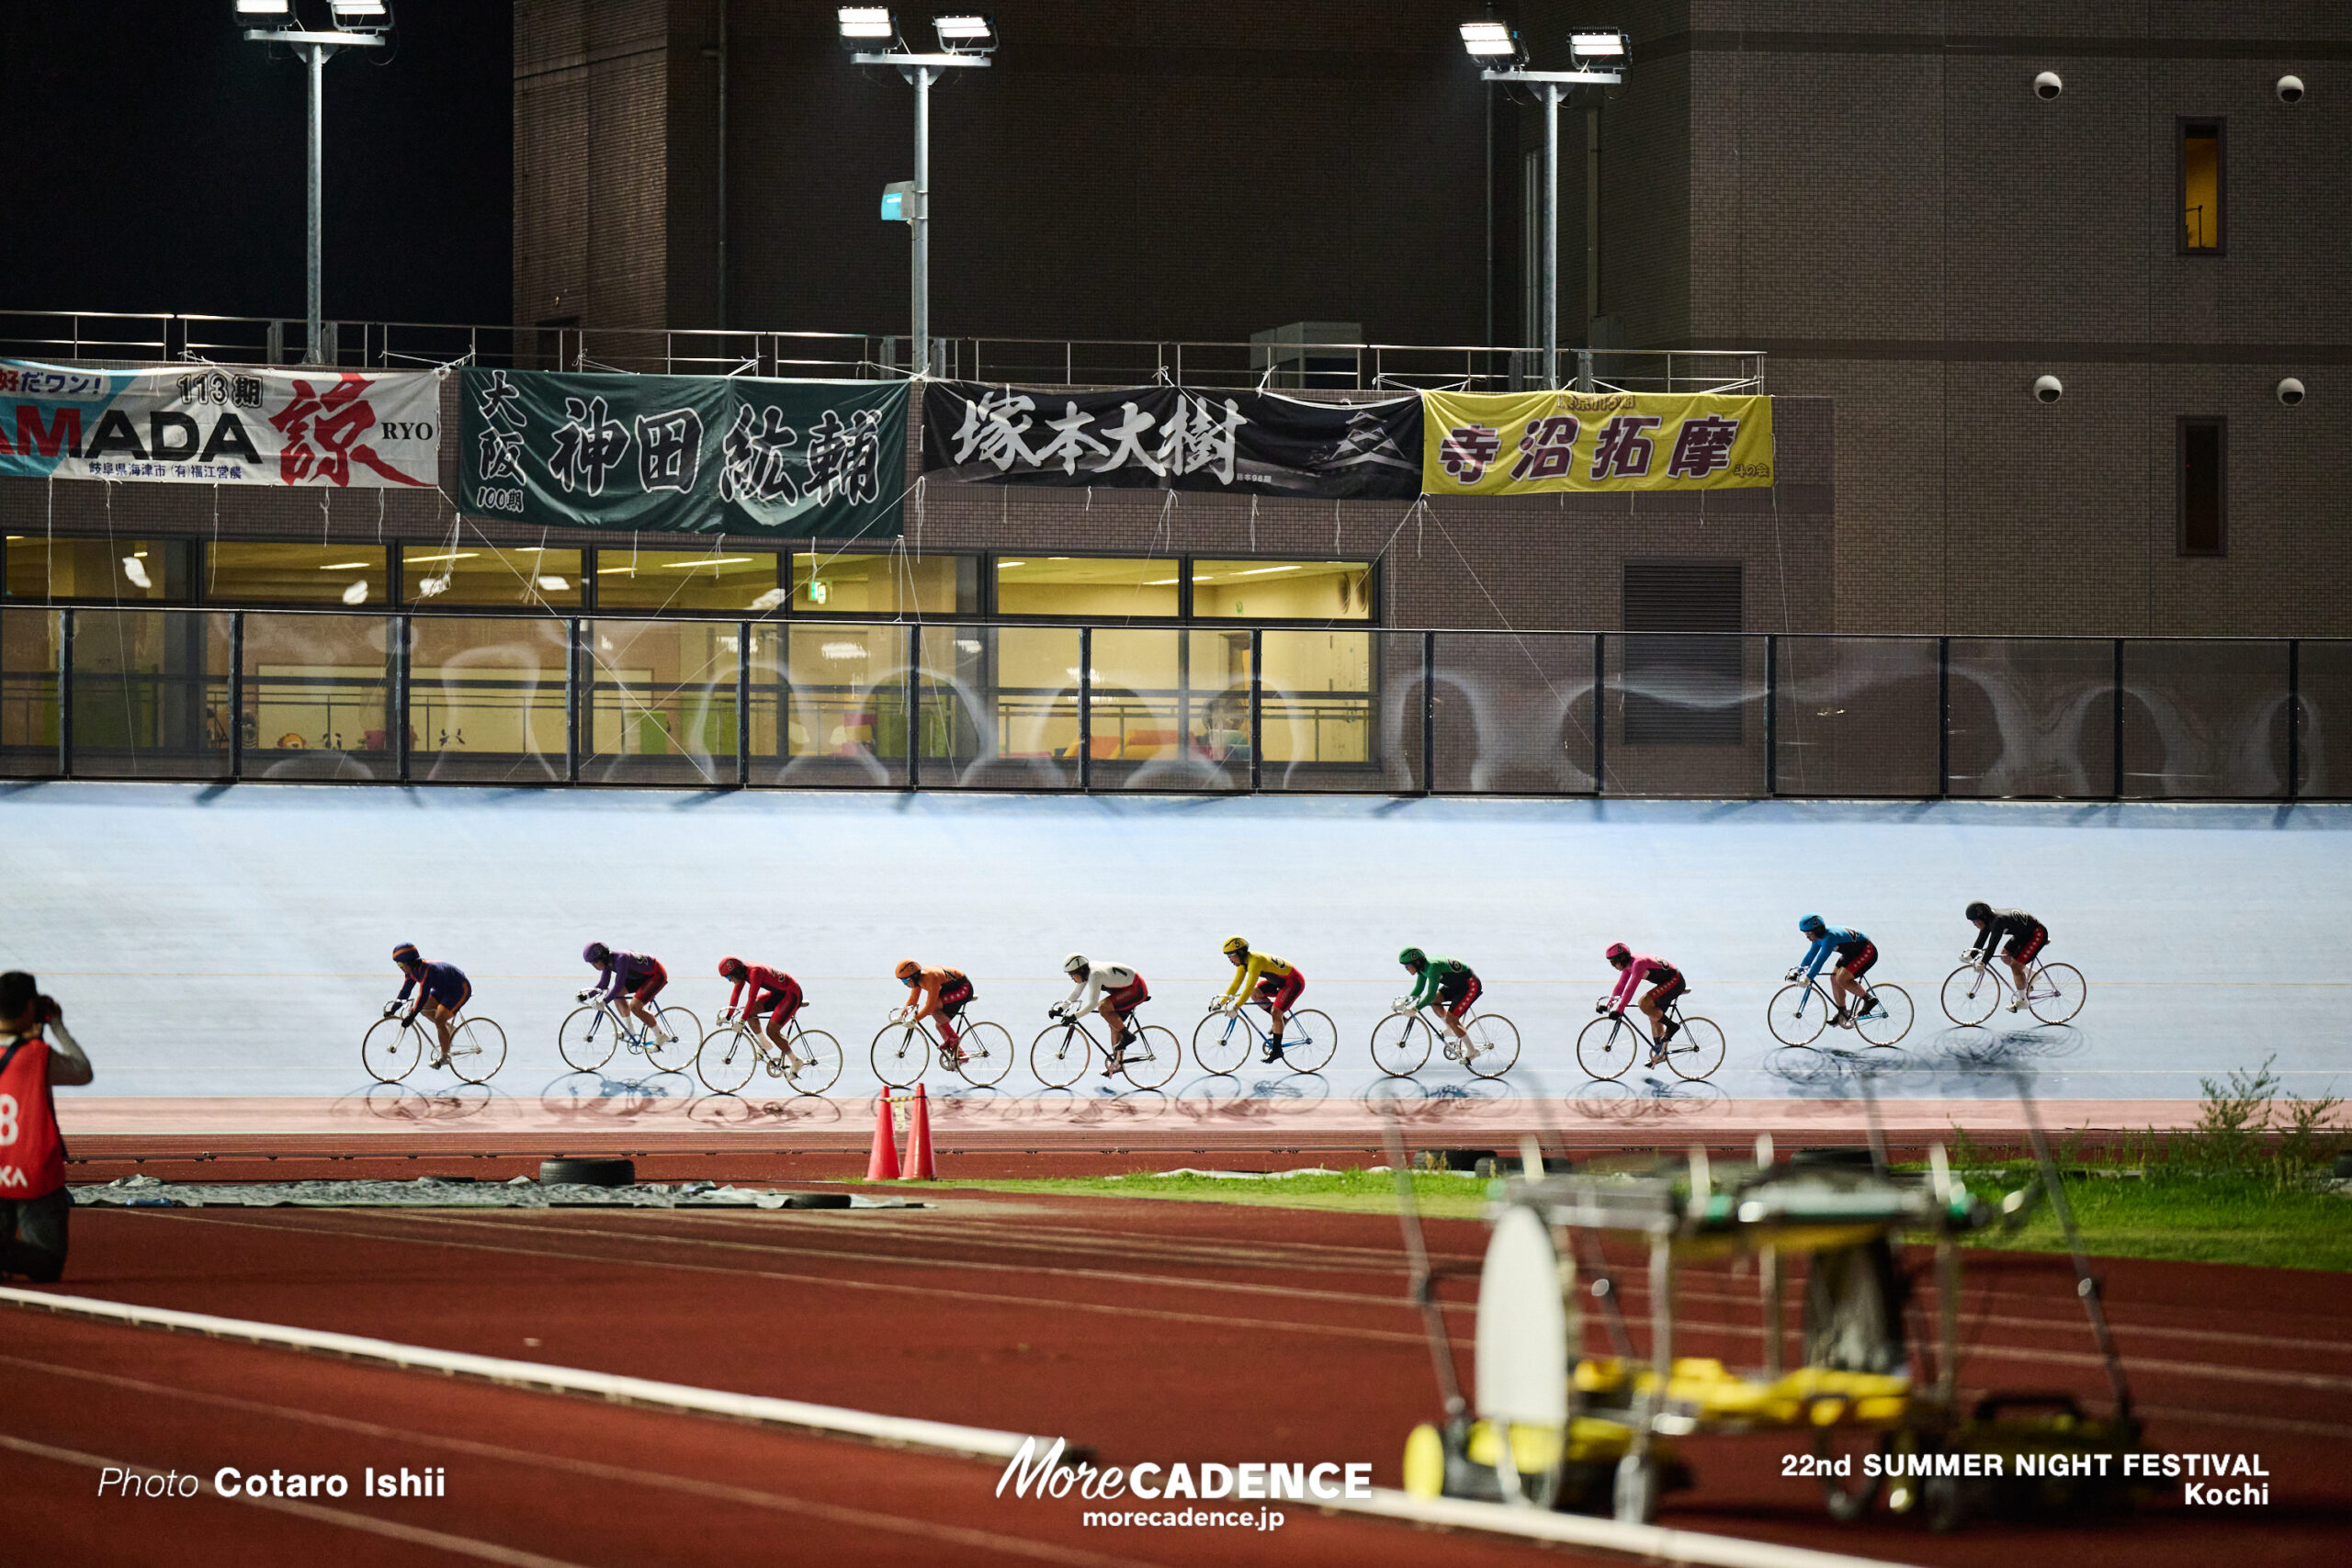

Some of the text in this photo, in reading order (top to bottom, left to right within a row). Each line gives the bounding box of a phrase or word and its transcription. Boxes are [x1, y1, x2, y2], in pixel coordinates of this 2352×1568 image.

[176, 373, 264, 408] 113期
[0, 405, 263, 464] MADA
[381, 422, 434, 441] RYO
[479, 370, 527, 486] 大阪
[951, 391, 1248, 485] 塚本大樹
[548, 395, 883, 507] 神田紘輔
[1438, 414, 1740, 484] 寺沼拓摩
[477, 486, 524, 513] 100期
[2012, 909, 2029, 926] 2
[1234, 940, 1240, 948] 5
[727, 961, 734, 971] 3
[1271, 955, 1285, 969] 5
[1448, 959, 1463, 973] 6
